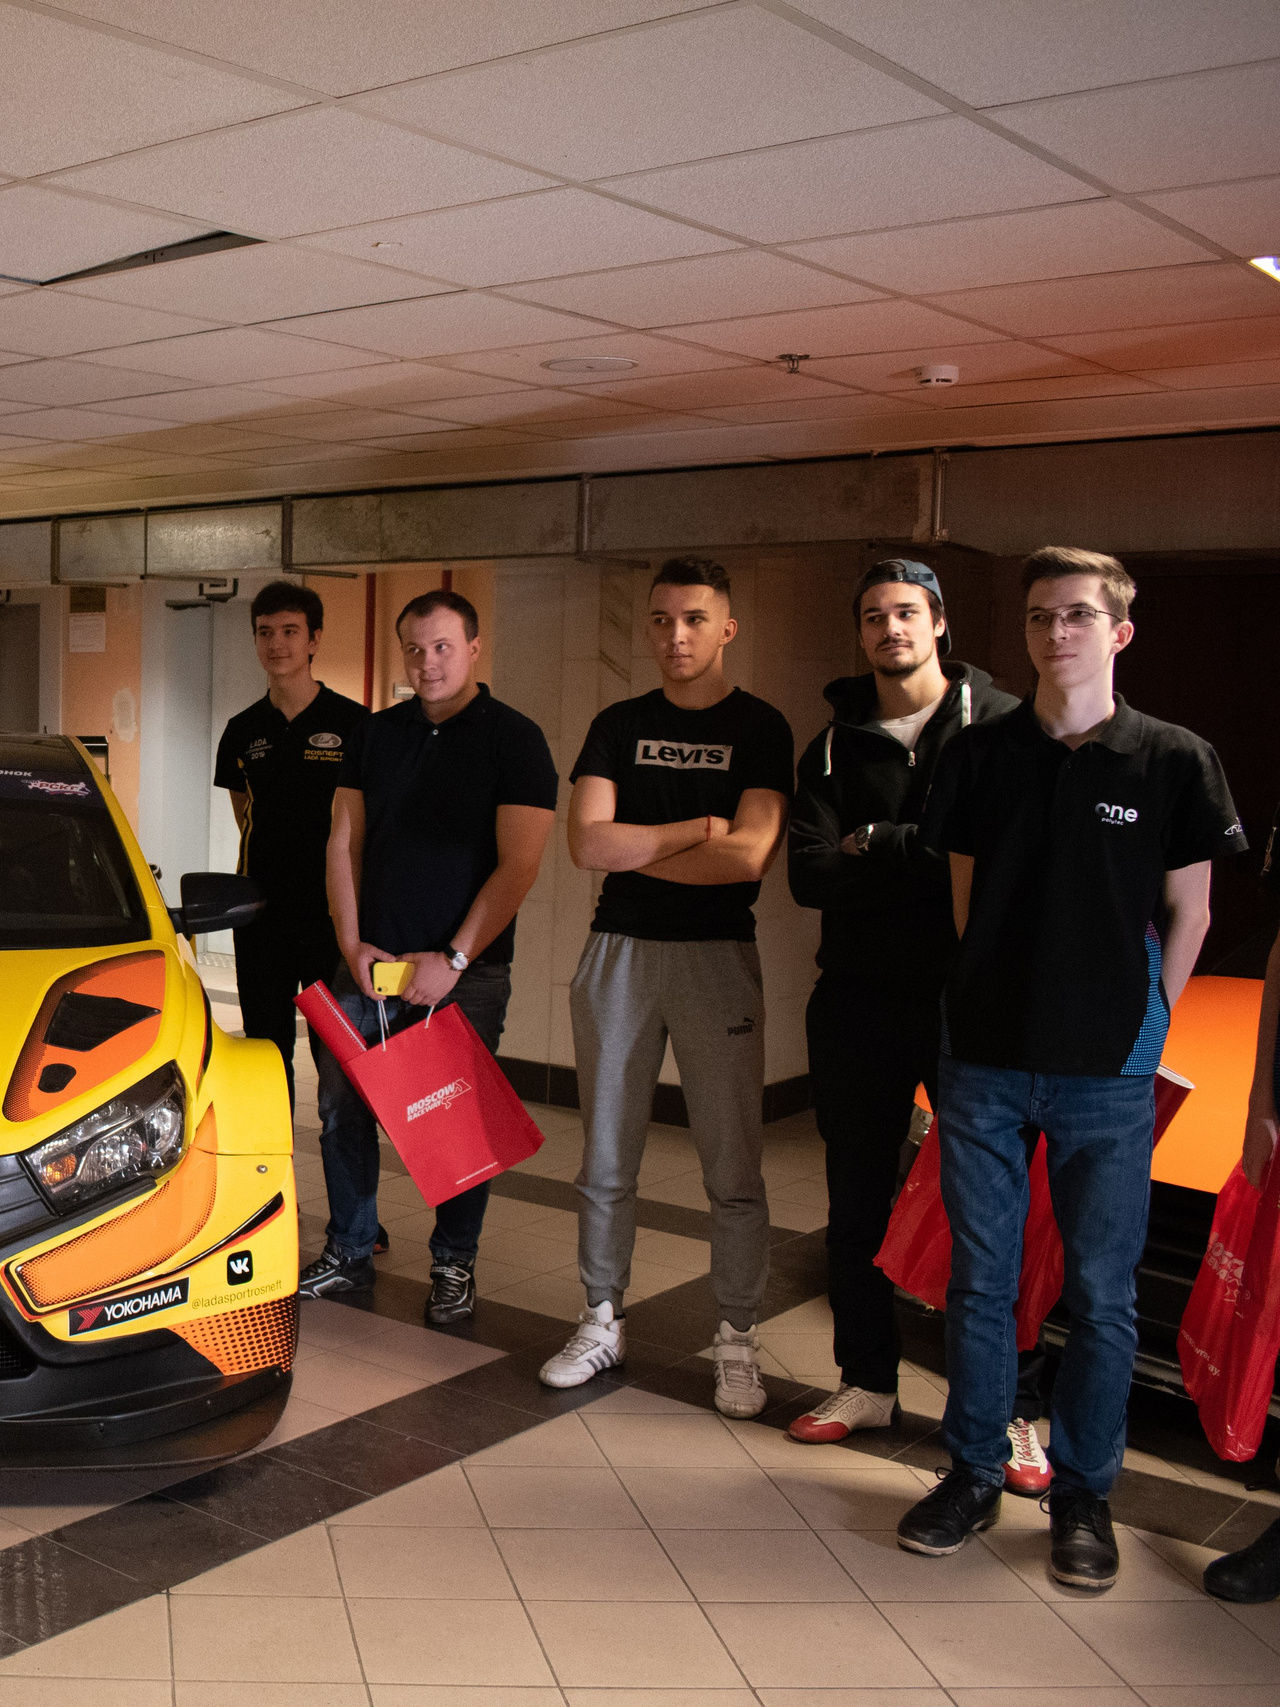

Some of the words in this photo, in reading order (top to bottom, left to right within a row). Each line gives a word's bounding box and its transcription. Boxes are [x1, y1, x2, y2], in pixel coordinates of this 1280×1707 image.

[249, 737, 268, 749] LADA
[251, 750, 266, 761] 2019
[407, 1081, 456, 1116] MOSCOW
[407, 1099, 443, 1123] RACEWAY
[104, 1285, 182, 1321] YOKOHAMA
